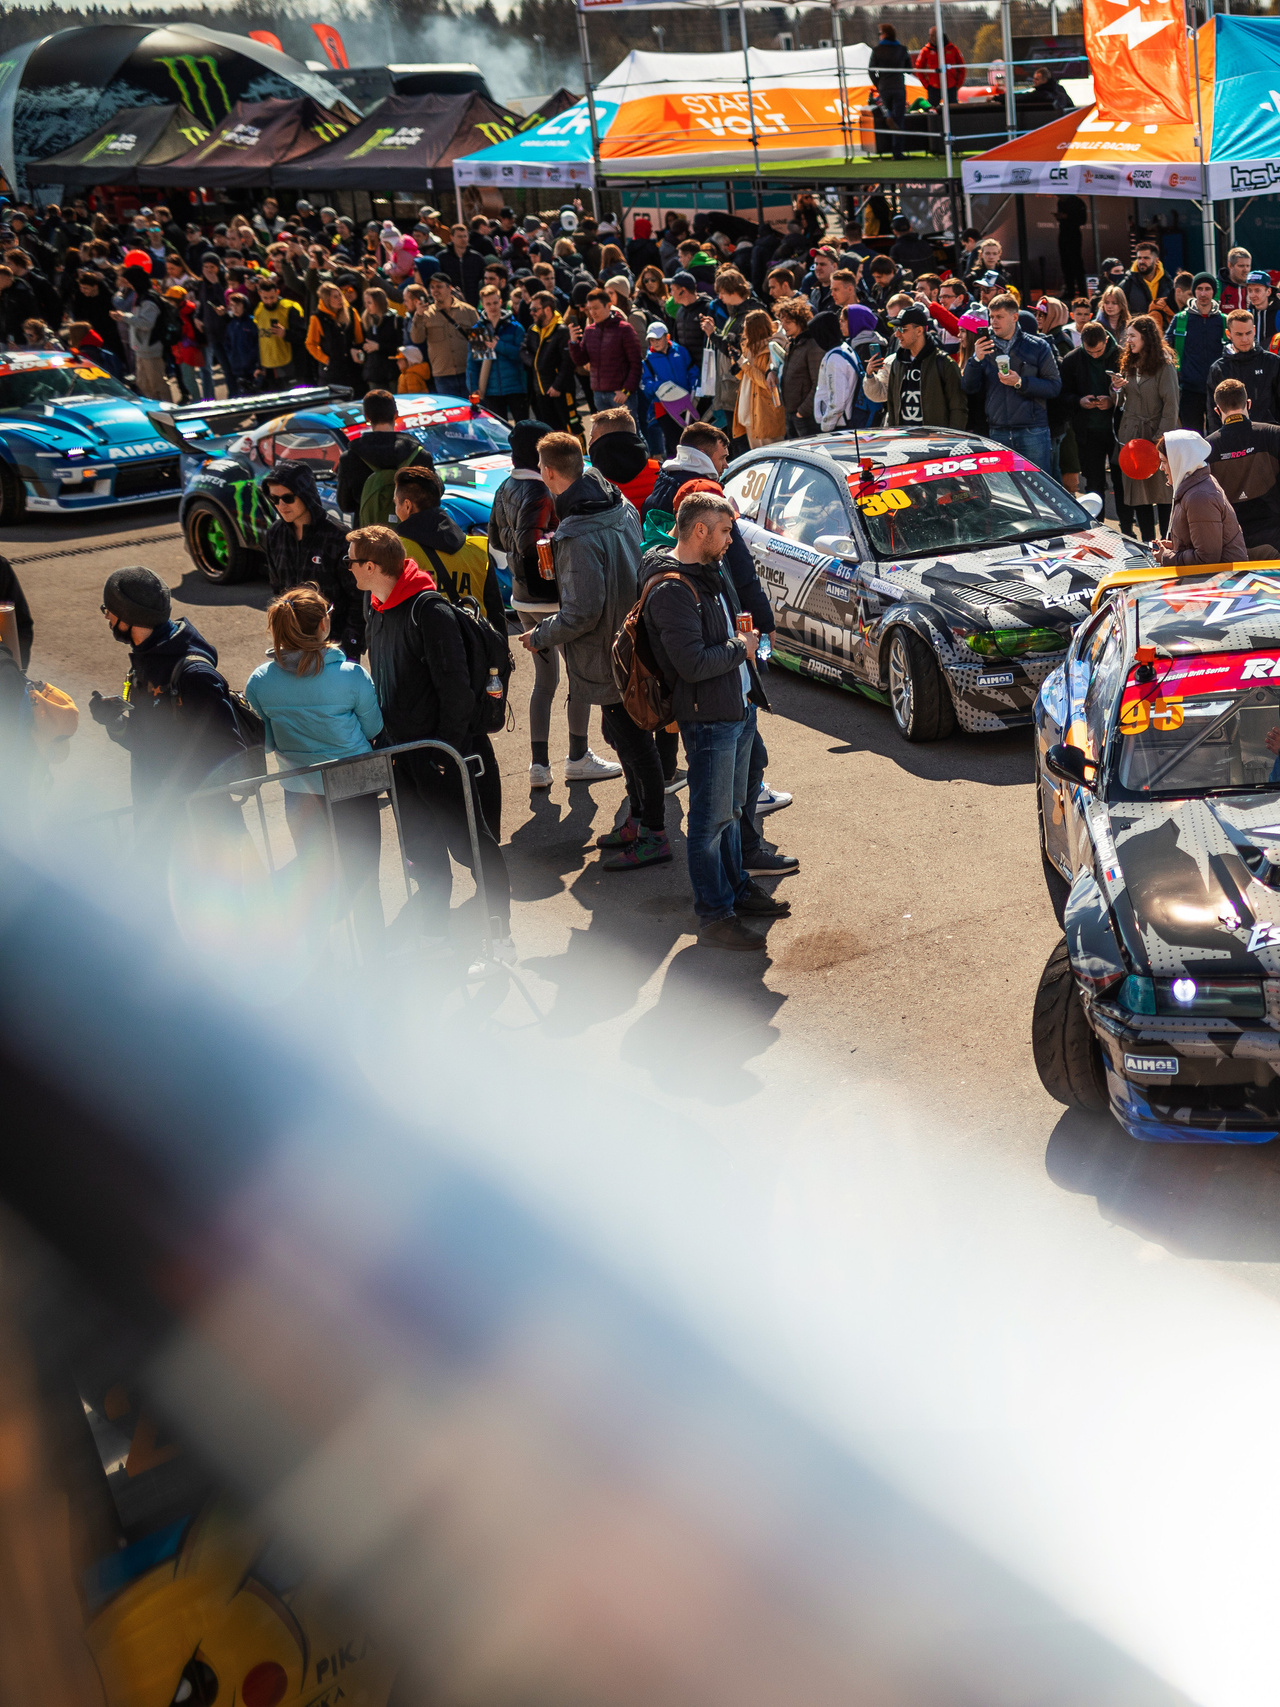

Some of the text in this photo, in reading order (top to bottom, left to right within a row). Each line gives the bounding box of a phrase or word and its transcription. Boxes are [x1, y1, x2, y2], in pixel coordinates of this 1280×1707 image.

[681, 92, 771, 114] START
[696, 113, 791, 136] VOLT
[1049, 168, 1068, 180] CR
[1132, 170, 1153, 178] START
[403, 411, 447, 428] RDS
[1230, 449, 1246, 458] RDS
[924, 458, 978, 477] RDS
[979, 457, 1000, 465] GP
[741, 469, 766, 501] 30
[856, 488, 913, 517] 30
[836, 562, 853, 580] ВТБ
[826, 584, 849, 600] AIMOL
[978, 676, 1012, 685] AIMOL
[1187, 669, 1204, 679] Drift
[1204, 666, 1230, 677] Series
[1119, 696, 1185, 736] 95
[1126, 1058, 1176, 1071] AIMOL
